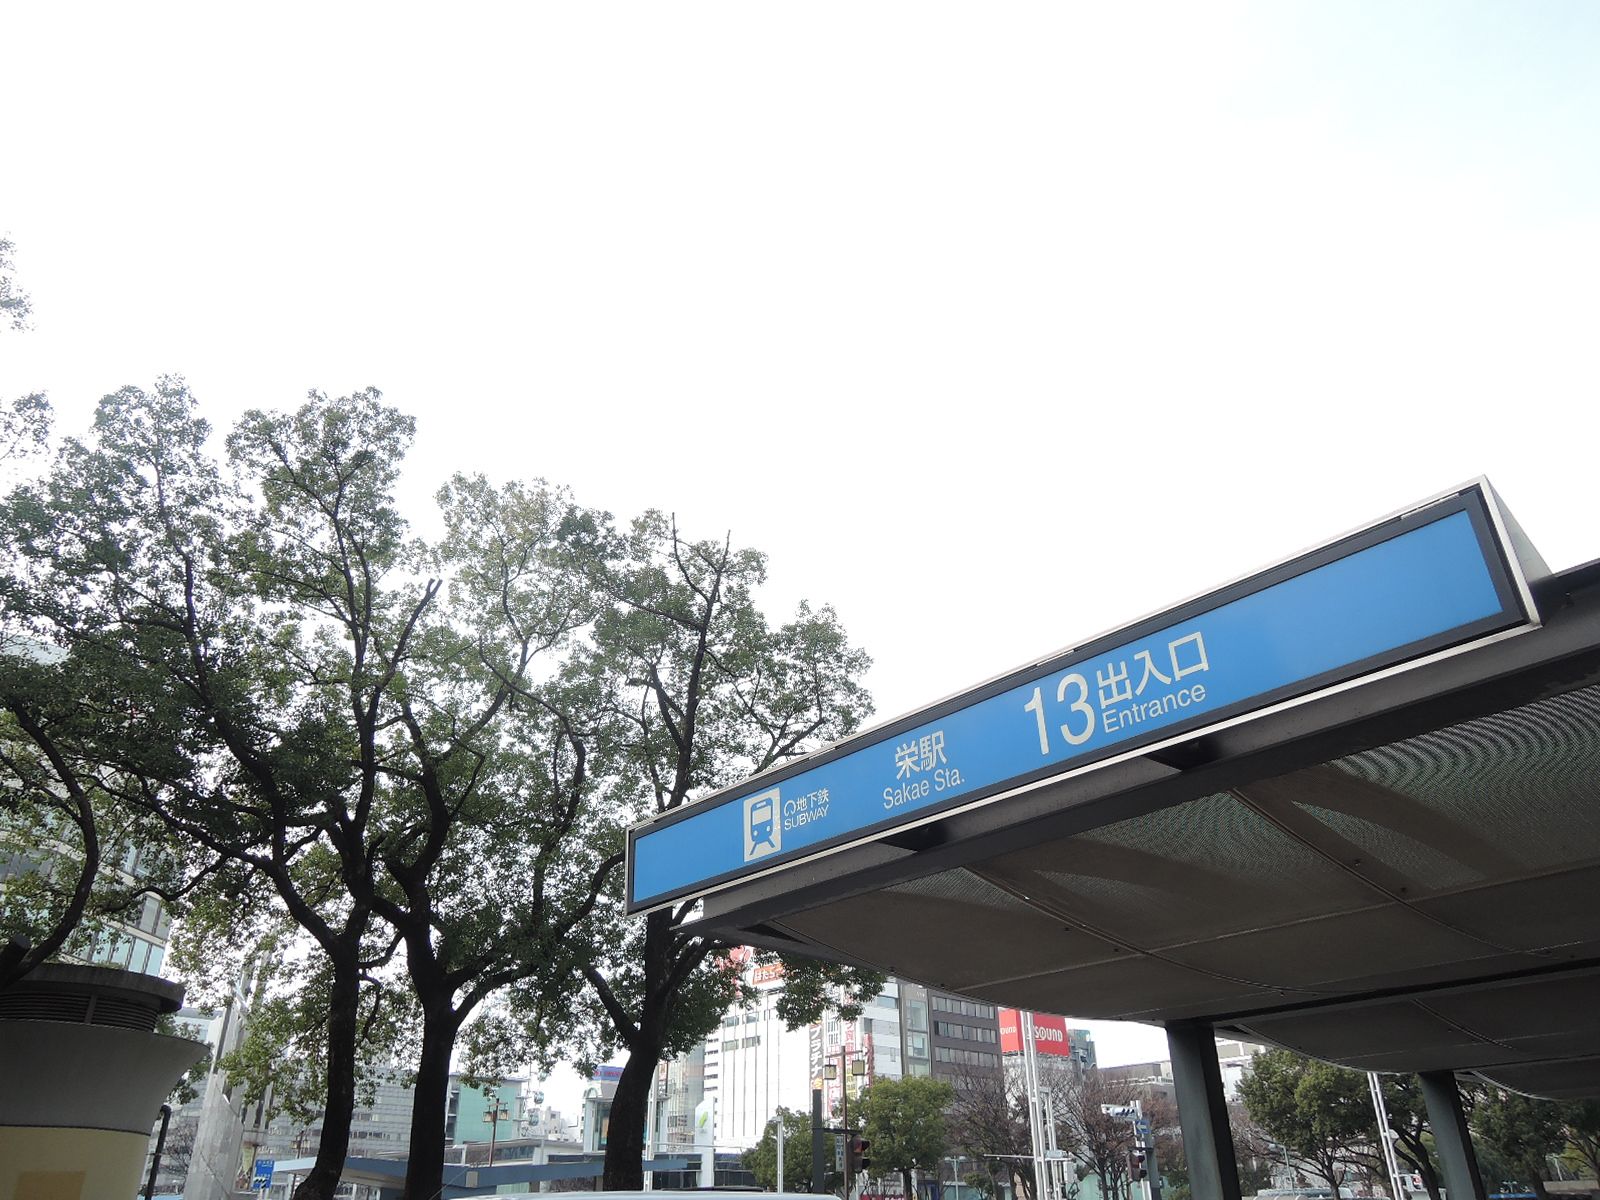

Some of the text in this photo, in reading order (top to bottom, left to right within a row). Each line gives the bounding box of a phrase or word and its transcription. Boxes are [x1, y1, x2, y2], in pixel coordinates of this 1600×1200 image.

[1024, 631, 1209, 755] 13 出入口
[1102, 684, 1206, 733] Entrance
[895, 730, 948, 780] 栄駅
[796, 788, 829, 812] 地下鉄
[883, 768, 965, 810] Sakae Sta.
[784, 804, 829, 831] SUBWAY
